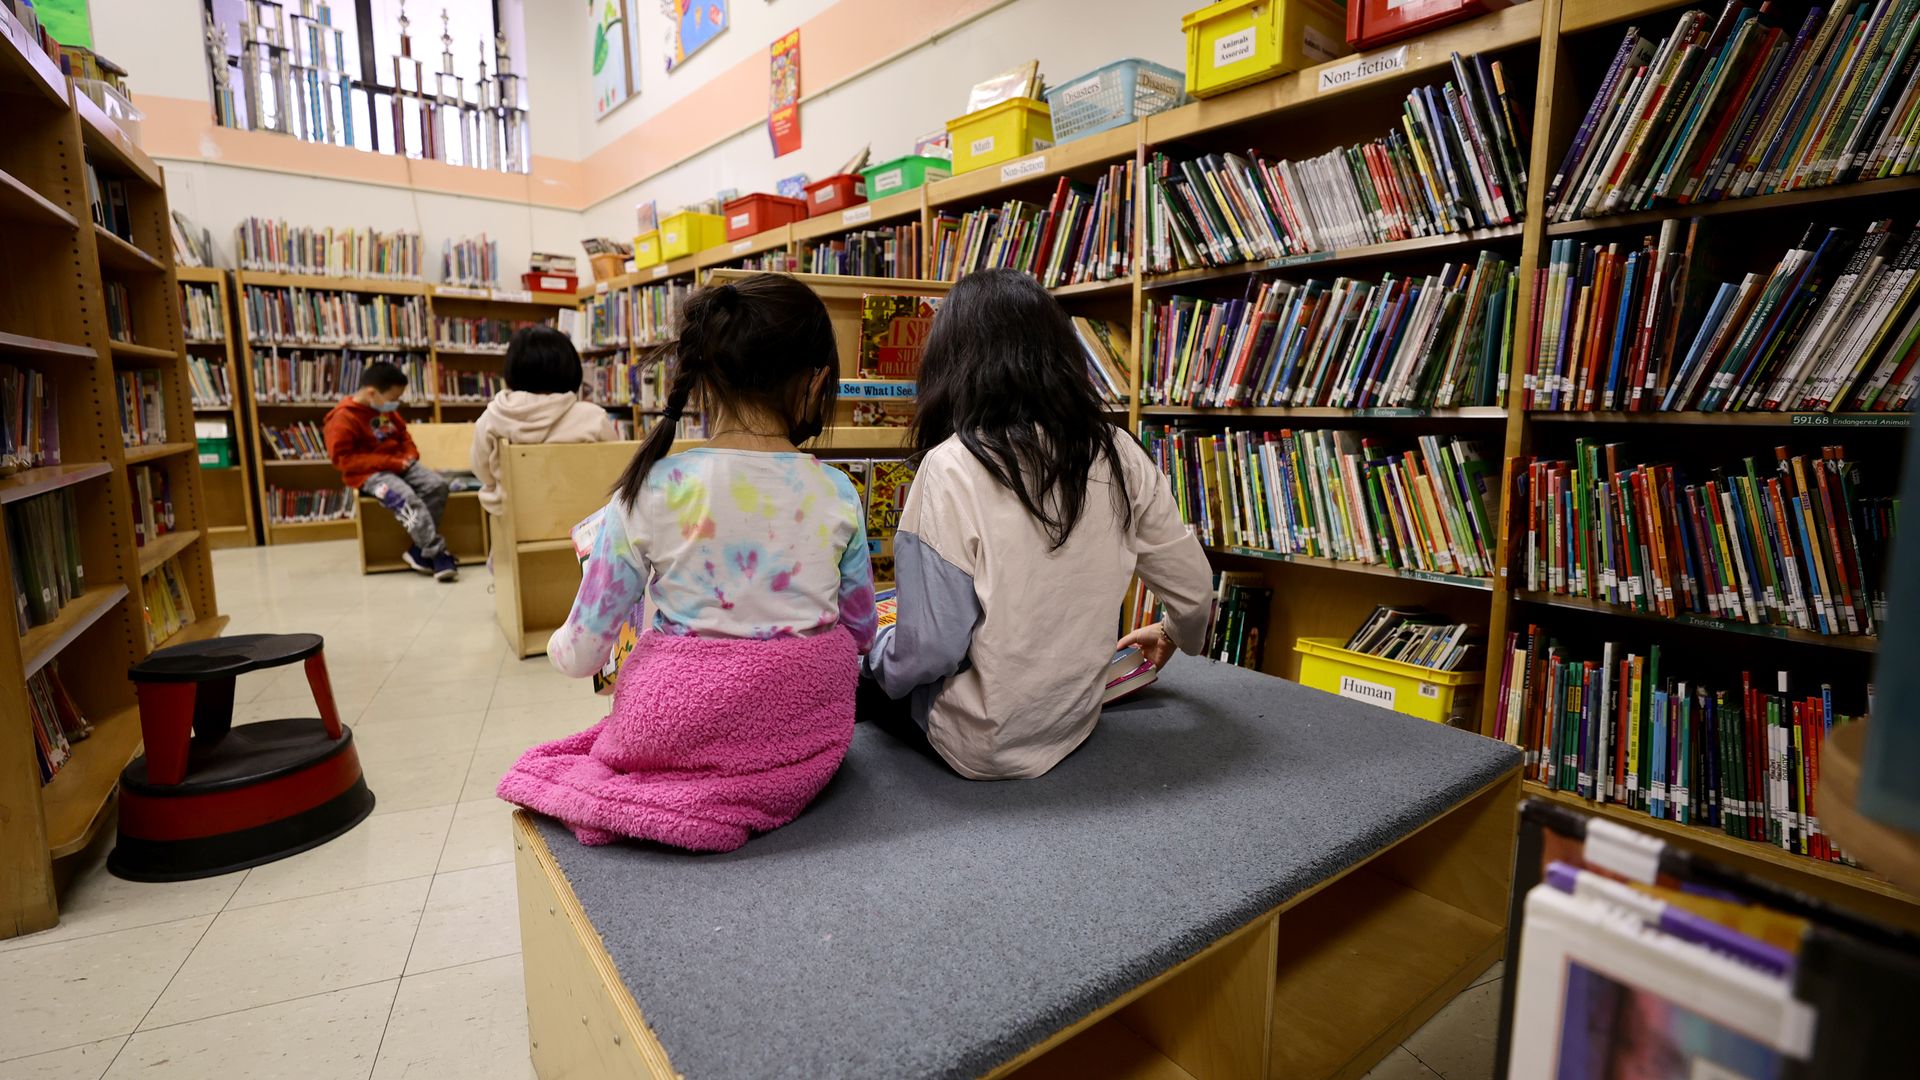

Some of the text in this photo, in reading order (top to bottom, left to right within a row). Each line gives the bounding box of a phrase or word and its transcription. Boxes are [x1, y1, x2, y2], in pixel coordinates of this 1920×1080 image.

[1222, 36, 1249, 50] Animals
[1220, 47, 1250, 61] Assorted
[1321, 56, 1404, 87] Non-fiction
[1601, 64, 1616, 89] ANIMAL
[1065, 81, 1100, 104] Disasters
[1142, 75, 1177, 96] Disasters
[1588, 89, 1604, 113] FACTS
[1664, 80, 1691, 123] ACTUAL SIZE
[1744, 113, 1760, 136] ANIMAL
[973, 141, 991, 153] Math
[1003, 160, 1044, 177] Non-fiction
[1872, 234, 1884, 247] SCARY
[1855, 249, 1873, 273] CREATURES
[892, 320, 900, 346] I
[1832, 327, 1846, 345] Animals
[843, 384, 861, 394] See
[864, 385, 889, 396] What
[896, 387, 913, 396] See
[1793, 416, 1829, 425] 591.68
[1833, 418, 1877, 426] Endangered
[1799, 491, 1812, 510] SPIDERS
[1426, 574, 1445, 582] Trees
[1689, 617, 1725, 629] Insects
[1343, 678, 1393, 701] Human
